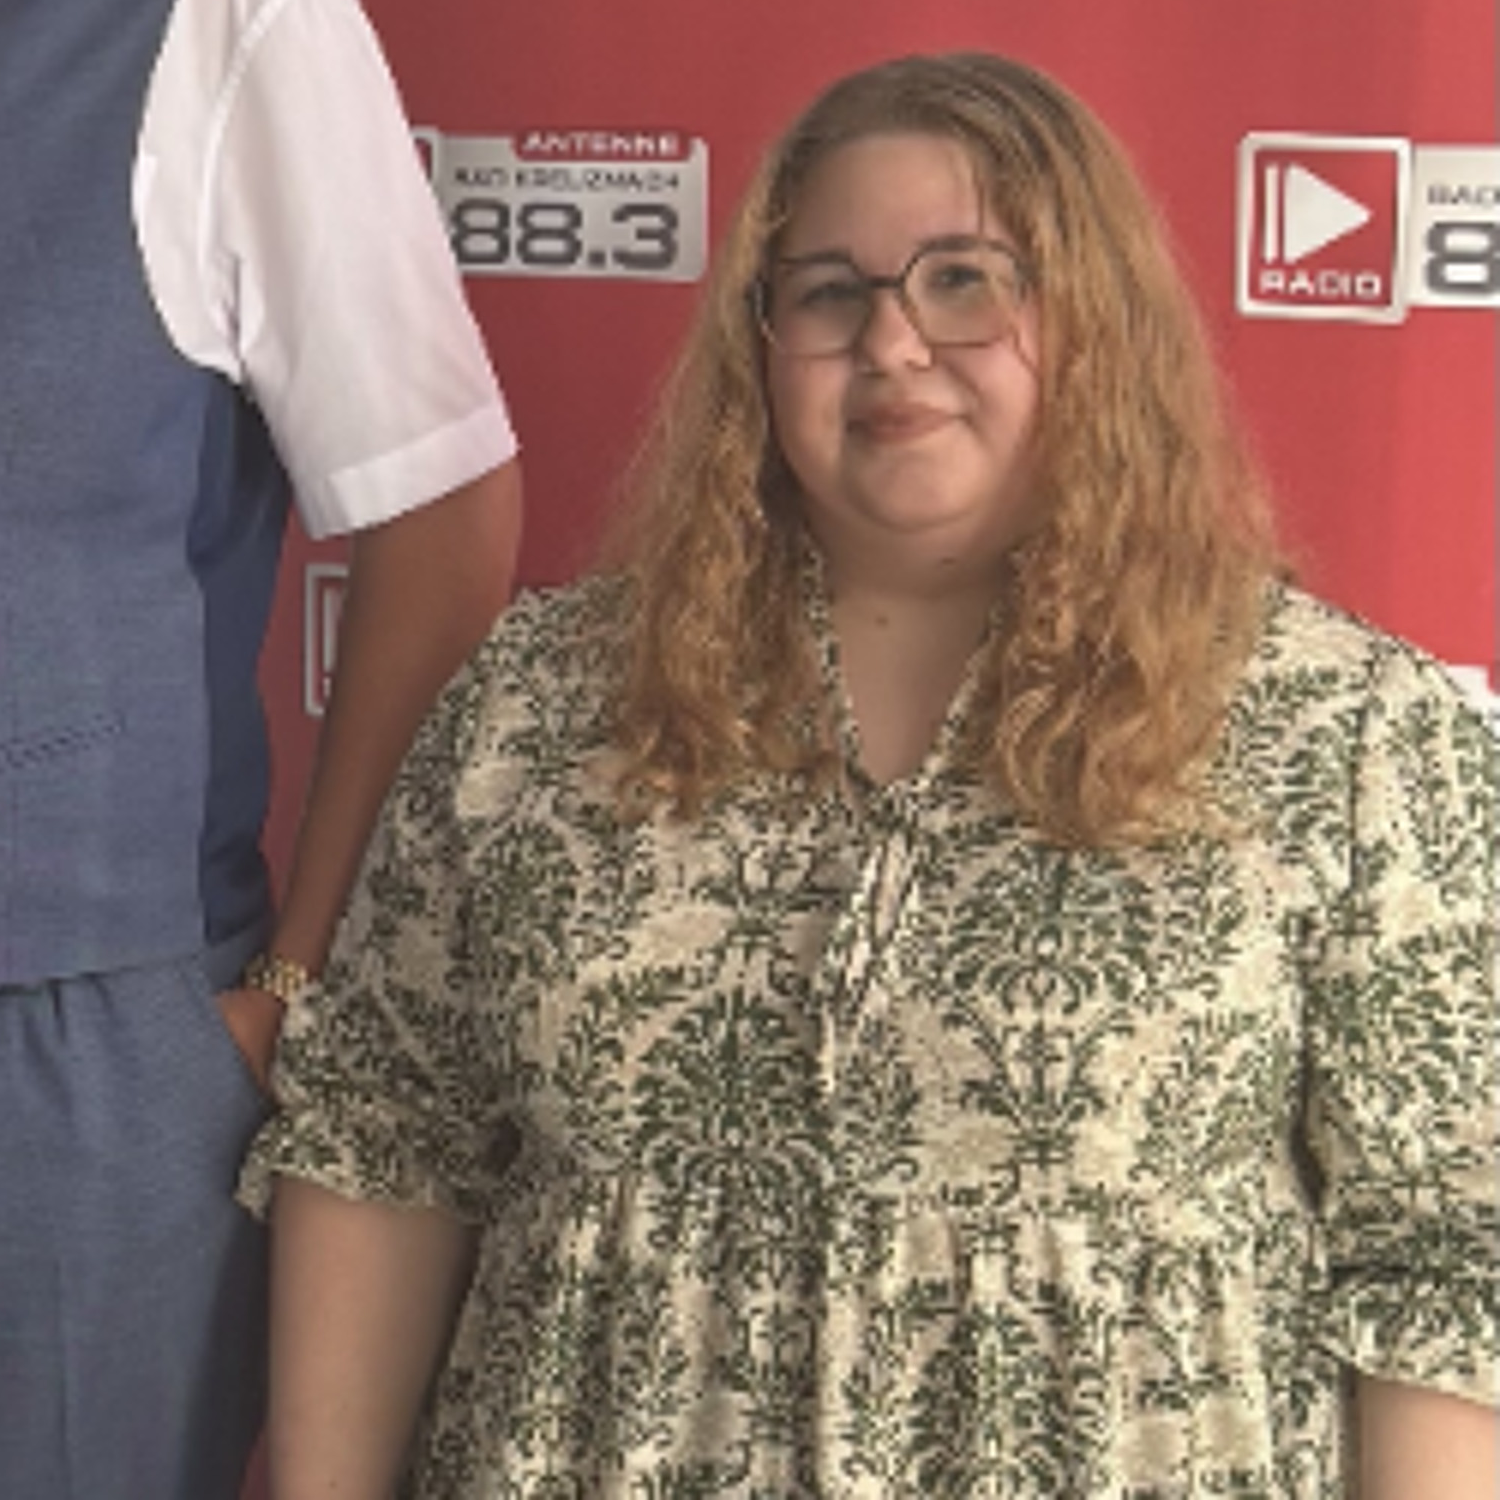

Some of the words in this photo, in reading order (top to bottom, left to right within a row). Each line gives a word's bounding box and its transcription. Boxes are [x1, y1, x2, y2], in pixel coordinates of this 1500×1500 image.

[521, 132, 681, 157] ANTENNE
[450, 198, 680, 271] 88.3
[1258, 268, 1382, 298] RADIO
